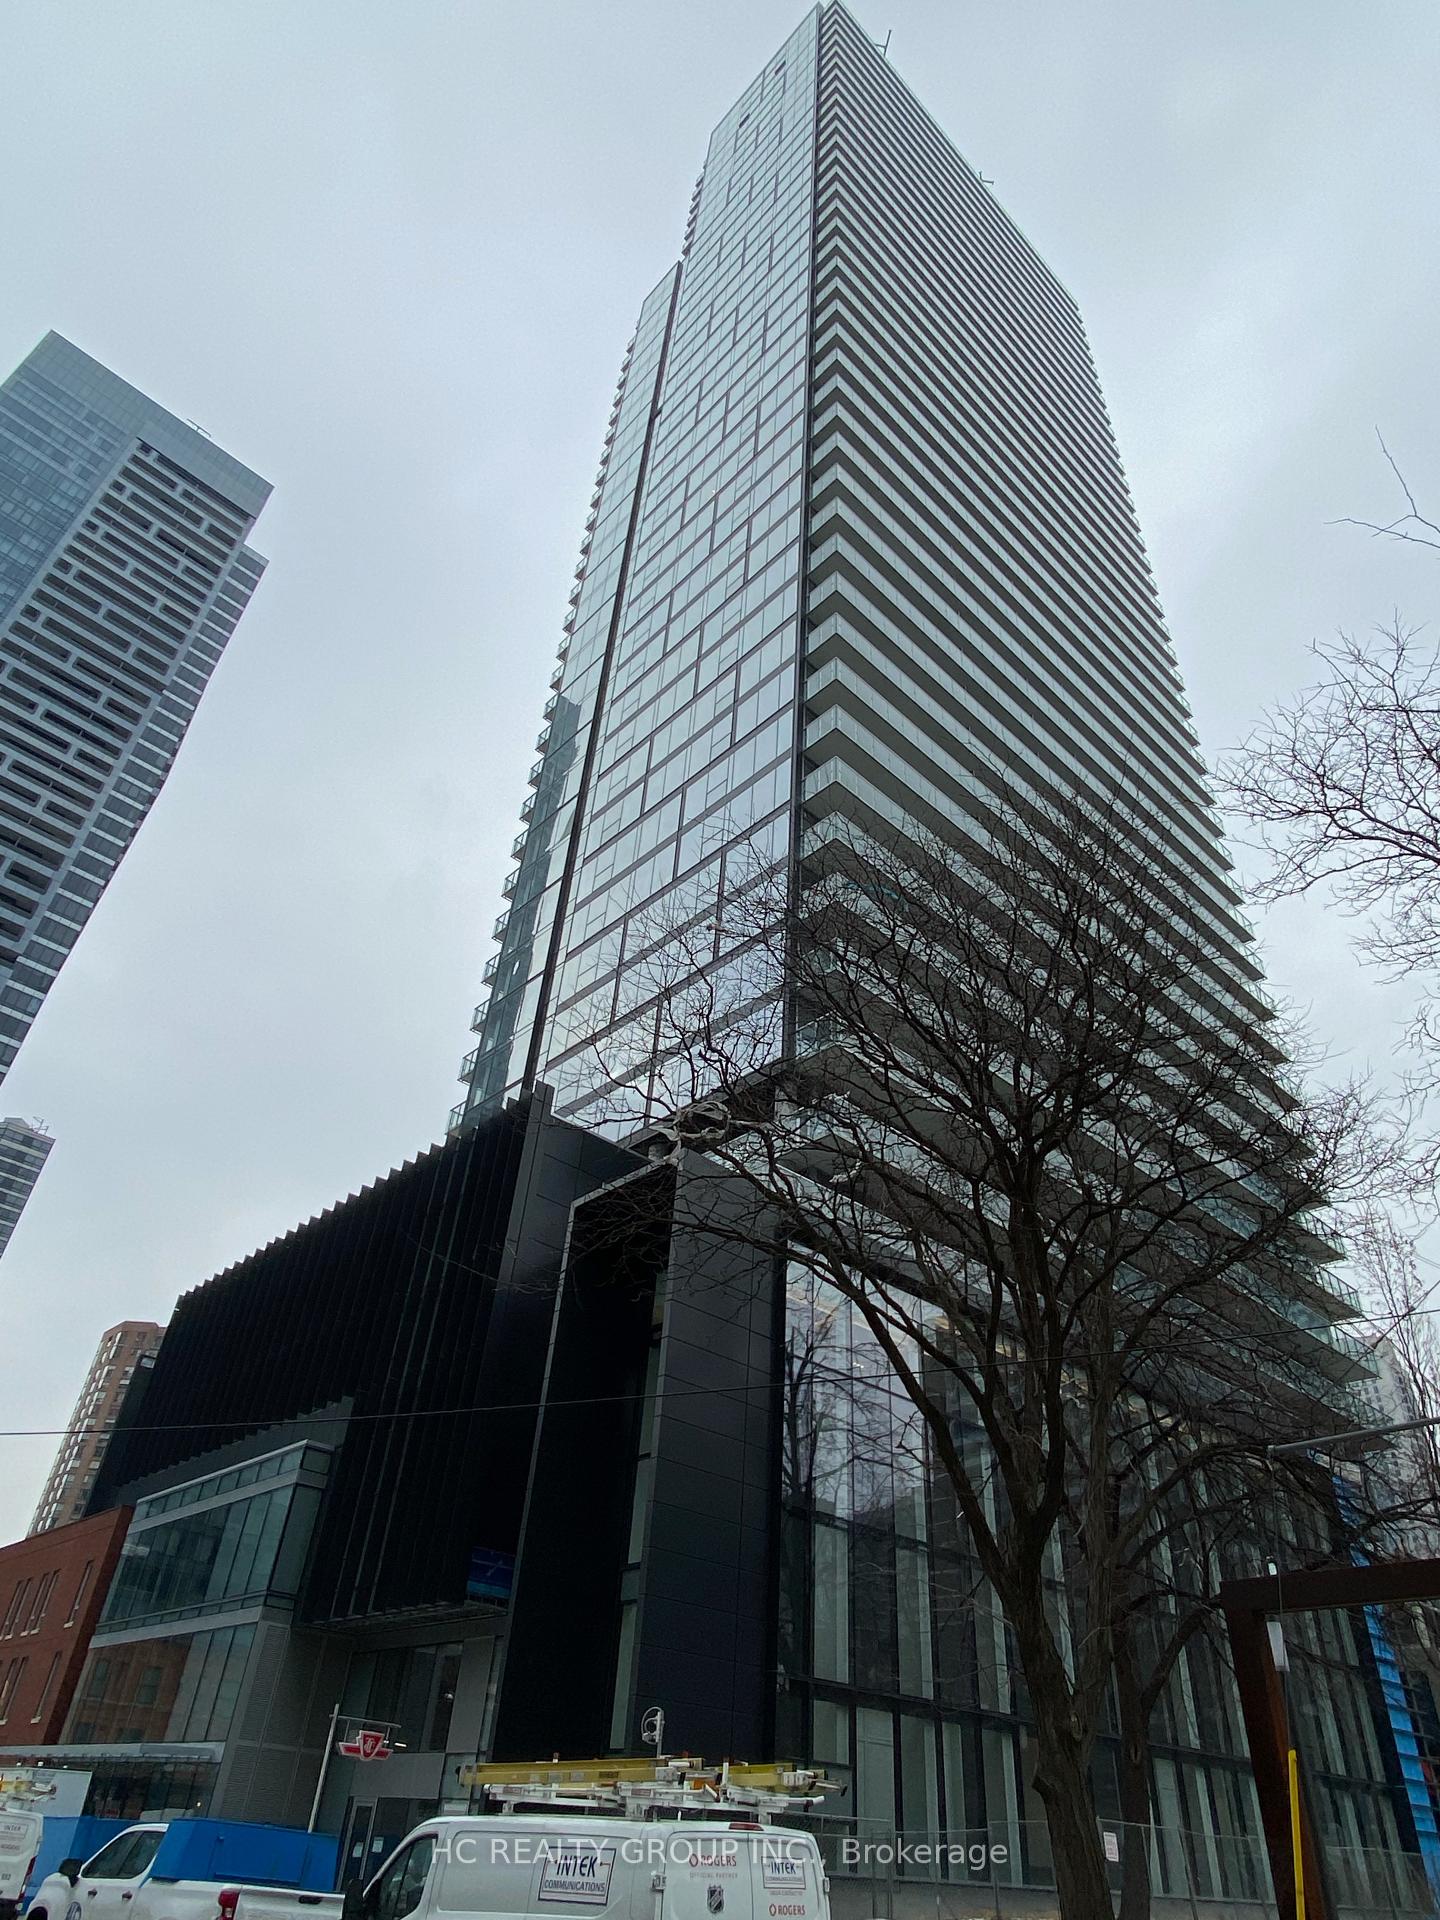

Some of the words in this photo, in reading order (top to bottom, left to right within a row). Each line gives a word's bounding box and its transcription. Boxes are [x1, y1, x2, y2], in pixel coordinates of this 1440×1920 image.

[555, 1854, 599, 1878] INTEK
[701, 1855, 737, 1867] ROGERS
[771, 1861, 796, 1875] INTEK
[544, 1879, 606, 1893] COMMUNICATIONS
[777, 1904, 806, 1916] ROGERS
